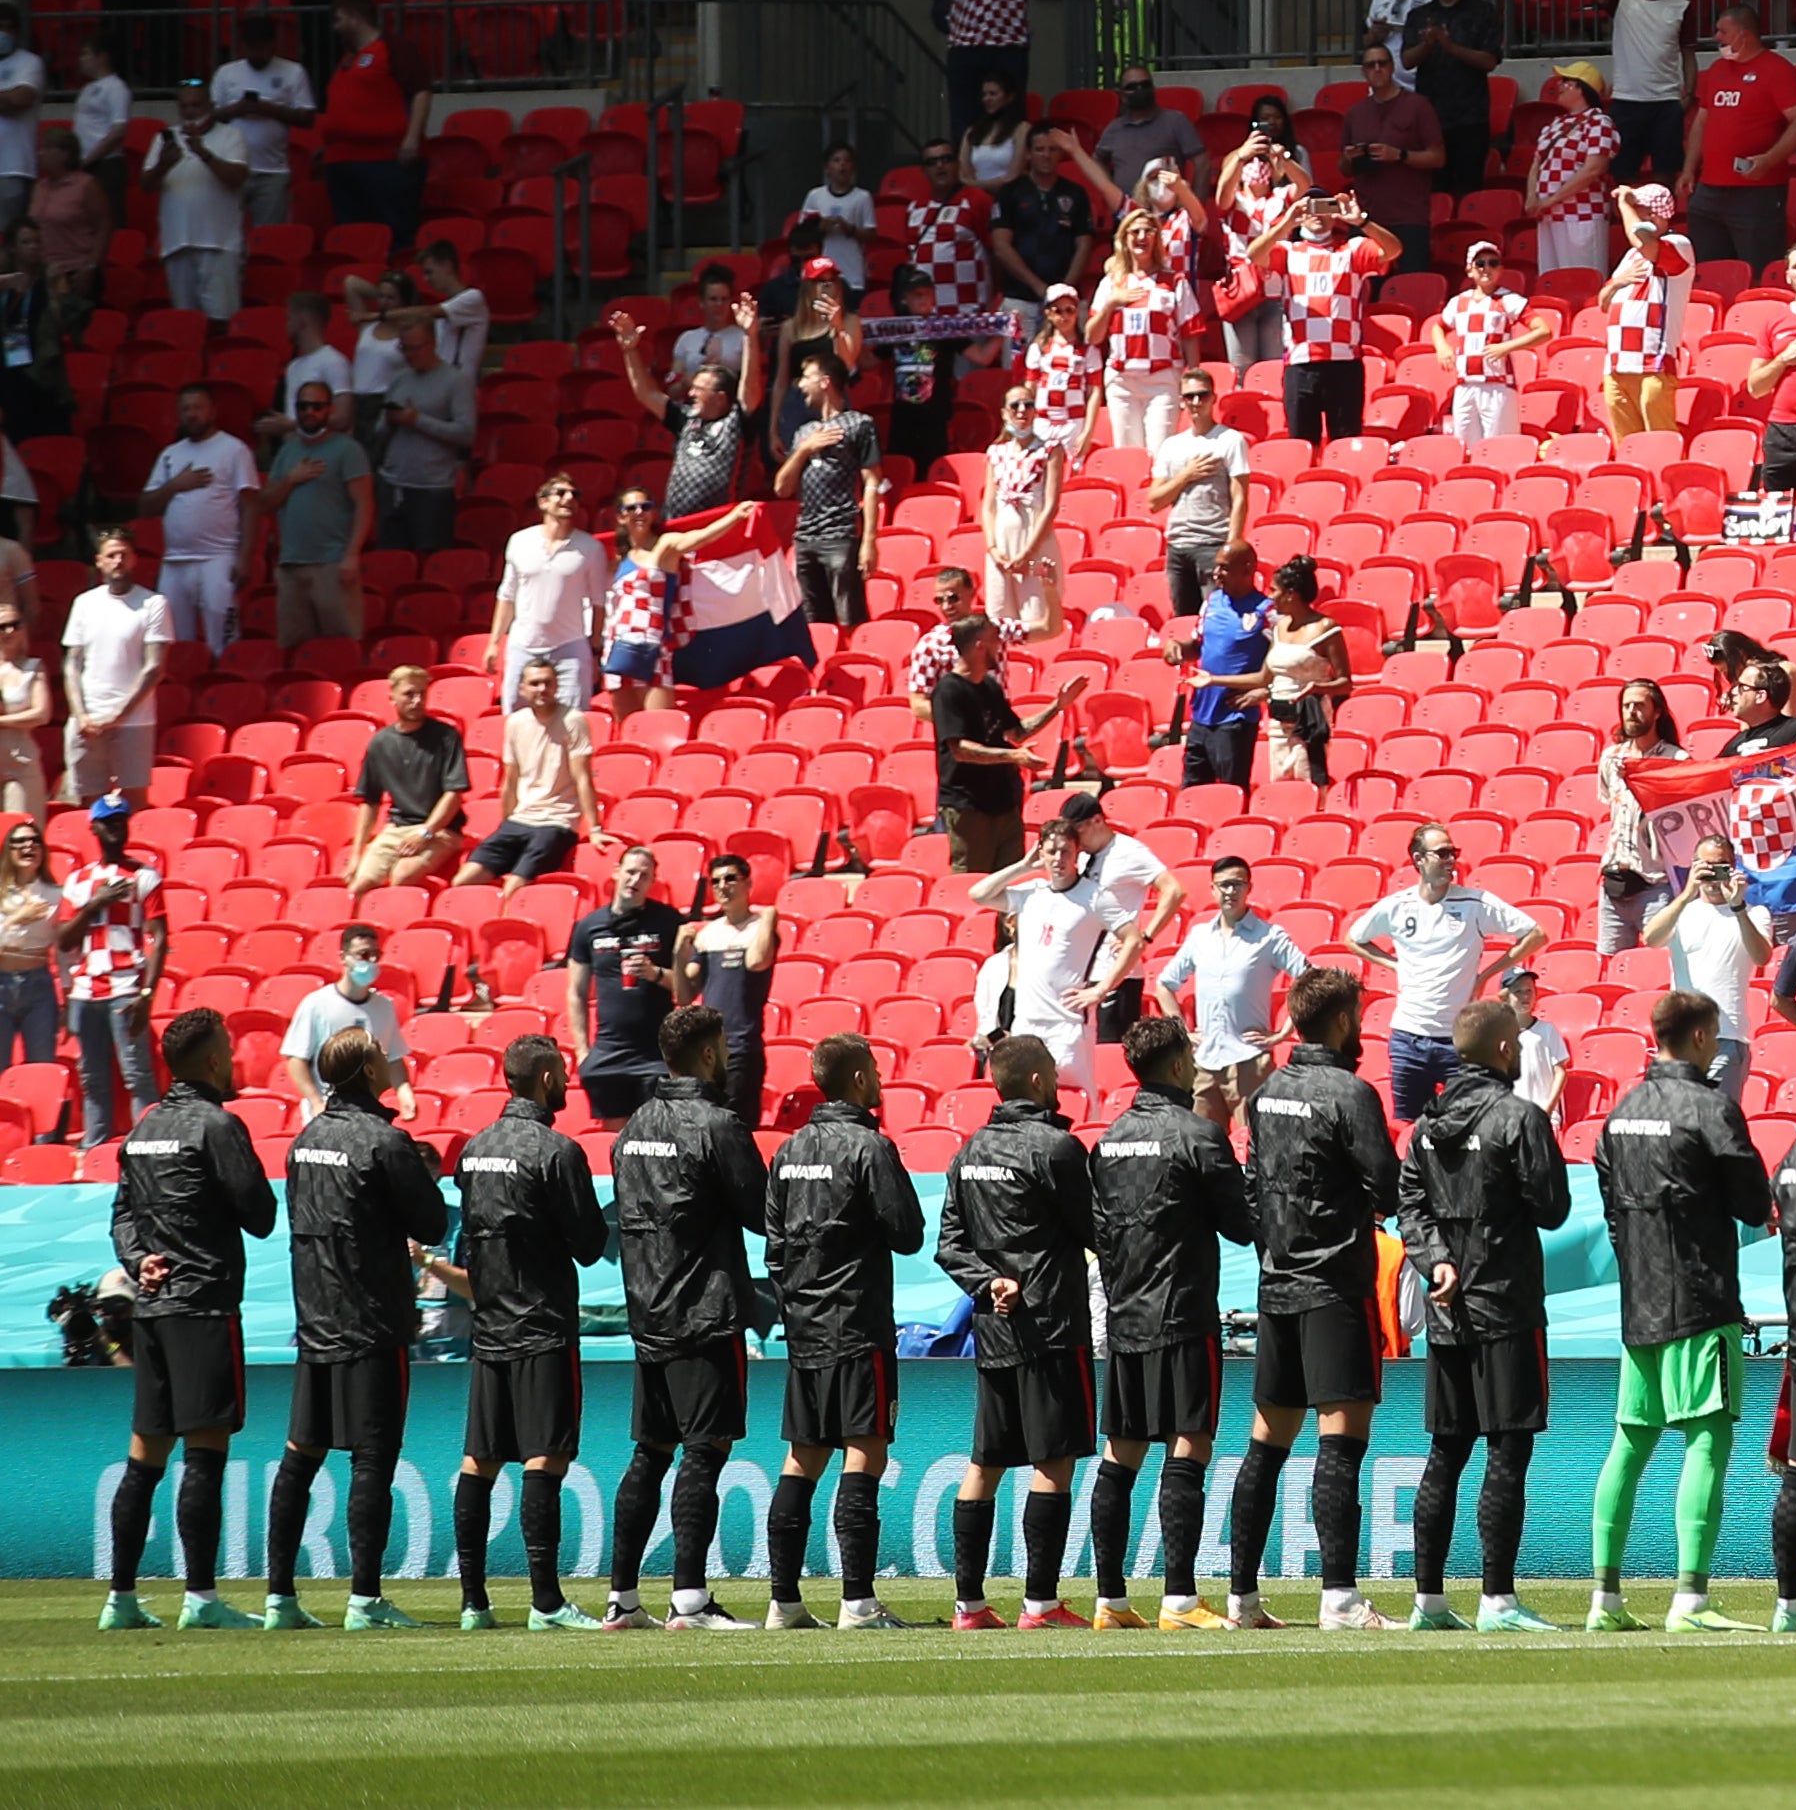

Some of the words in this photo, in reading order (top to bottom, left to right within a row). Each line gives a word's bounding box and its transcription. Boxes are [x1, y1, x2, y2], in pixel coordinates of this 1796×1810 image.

[1713, 90, 1741, 107] CRO
[1404, 916, 1418, 938] 9
[1257, 1096, 1312, 1118] HRVATSKA
[1609, 1118, 1671, 1137] HRVATSKA
[126, 1139, 180, 1155] HRVATSKA
[623, 1140, 678, 1158] HRVATSKA
[1101, 1140, 1160, 1157] HRVATSKA
[295, 1147, 349, 1167] HRVATSKA
[463, 1156, 517, 1174] HRVATSKA
[780, 1164, 833, 1180] HRVATSKA
[961, 1164, 1016, 1181] HRVATSKA
